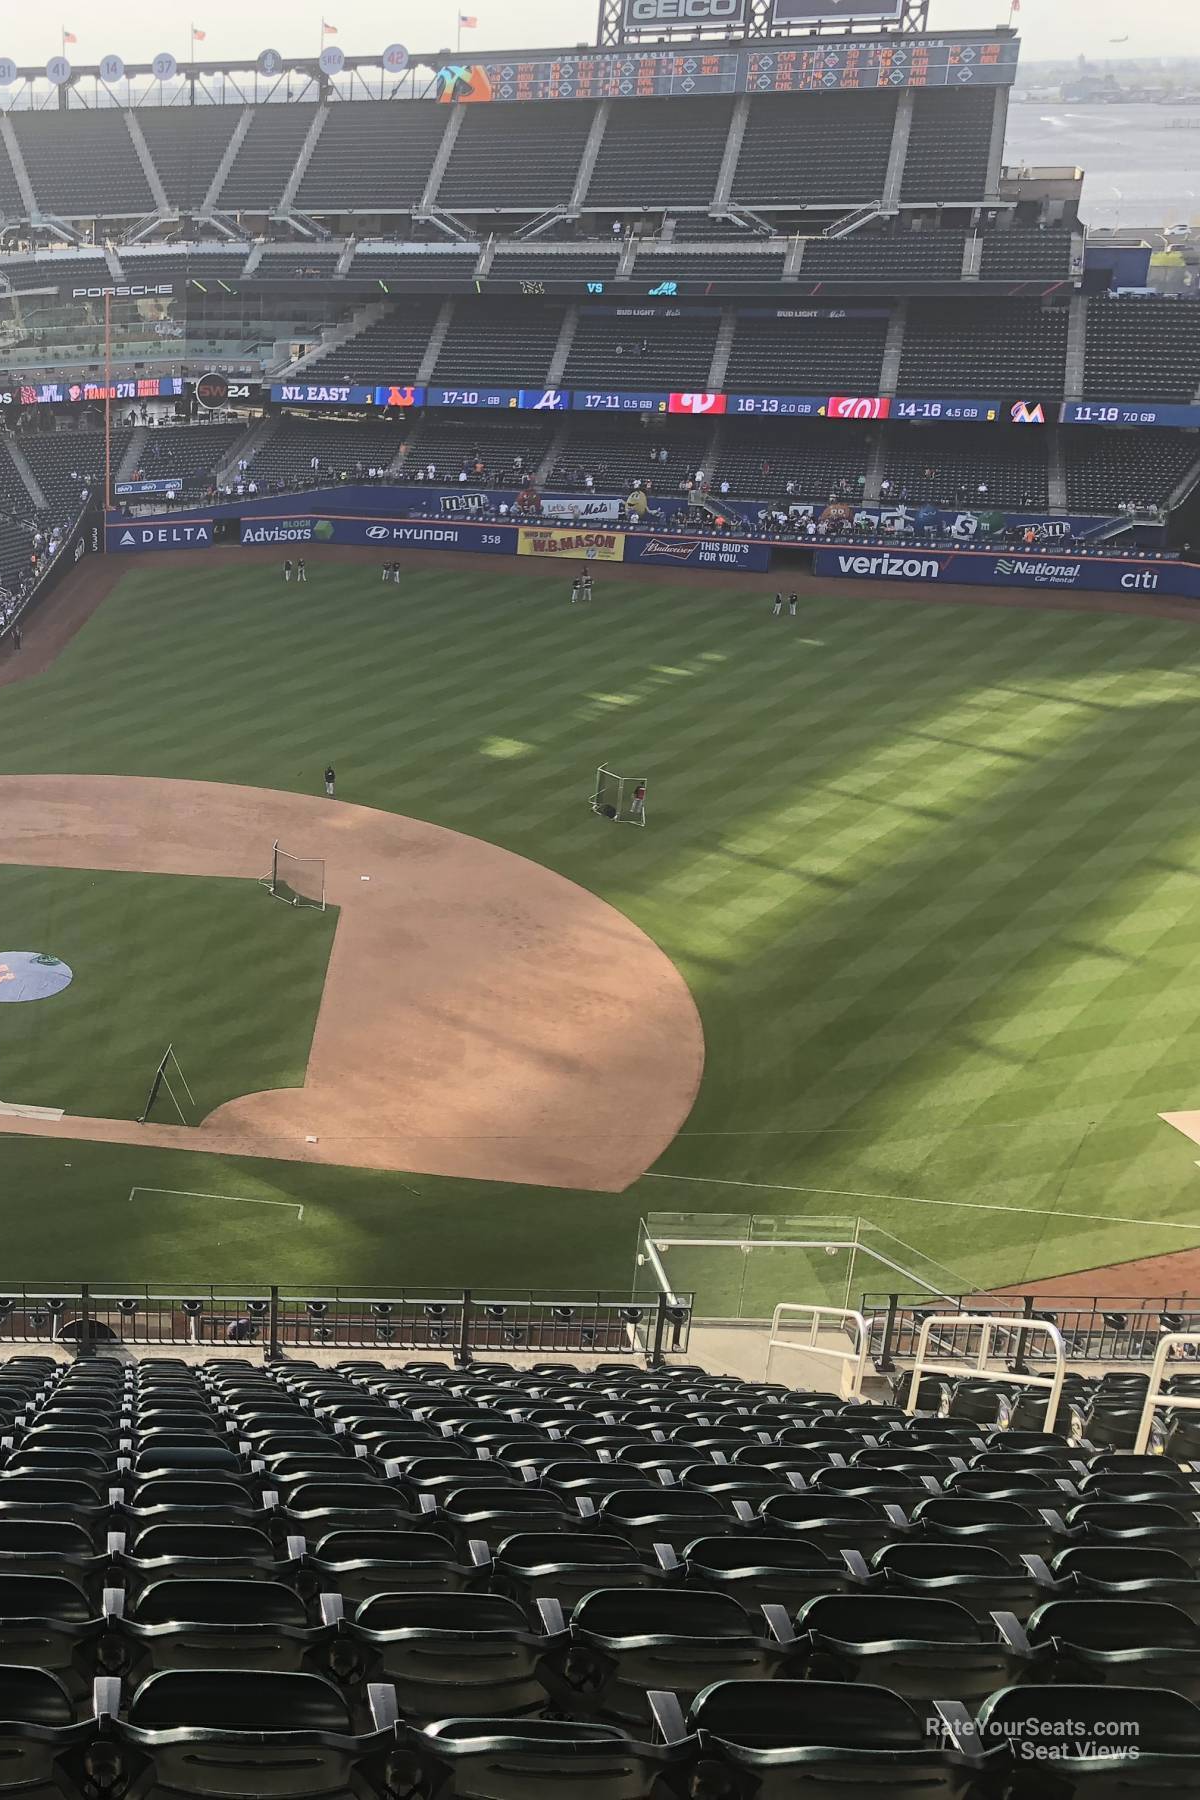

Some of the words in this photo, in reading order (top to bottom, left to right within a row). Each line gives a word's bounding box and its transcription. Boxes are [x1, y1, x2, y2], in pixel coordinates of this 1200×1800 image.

[632, 0, 736, 20] GEICO
[817, 42, 883, 51] NATIONAL
[892, 40, 944, 48] LEAGUE
[388, 51, 404, 65] 42
[555, 54, 619, 62] AMERICAN
[626, 52, 675, 60] LEAGUE
[52, 63, 65, 76] 41
[106, 62, 118, 74] 14
[157, 60, 172, 73] 37
[72, 284, 173, 298] PORSCHE
[587, 283, 603, 292] VS
[116, 383, 136, 398] 276
[228, 386, 250, 397] 24
[281, 386, 304, 401] NL
[307, 387, 350, 402] EAST
[365, 394, 373, 404] 1
[442, 391, 478, 404] 17-10
[487, 396, 500, 405] GB
[585, 394, 621, 408] 17-11
[623, 400, 638, 409] 0.5
[659, 401, 667, 412] 3
[780, 404, 796, 413] 2.0
[798, 404, 811, 413] GB
[817, 405, 826, 416] 4
[945, 408, 961, 417] 4.5
[964, 408, 978, 418] GB
[986, 410, 995, 421] 5
[1074, 407, 1118, 421] 11-18
[1123, 412, 1138, 422] 7.0
[1140, 412, 1156, 422] GB
[142, 527, 208, 543] DELTA
[242, 527, 311, 542] Advisors
[393, 528, 458, 542] HYUNDAI
[481, 534, 502, 545] 358
[646, 542, 694, 554] Budweiser
[700, 541, 721, 552] THIS
[722, 543, 749, 554] BUD'S
[699, 551, 717, 562] FOR
[718, 553, 739, 563] YOU.
[838, 553, 939, 578] verizon
[1034, 575, 1049, 583] Car
[1049, 576, 1076, 584] Rental
[1120, 571, 1158, 589] citi
